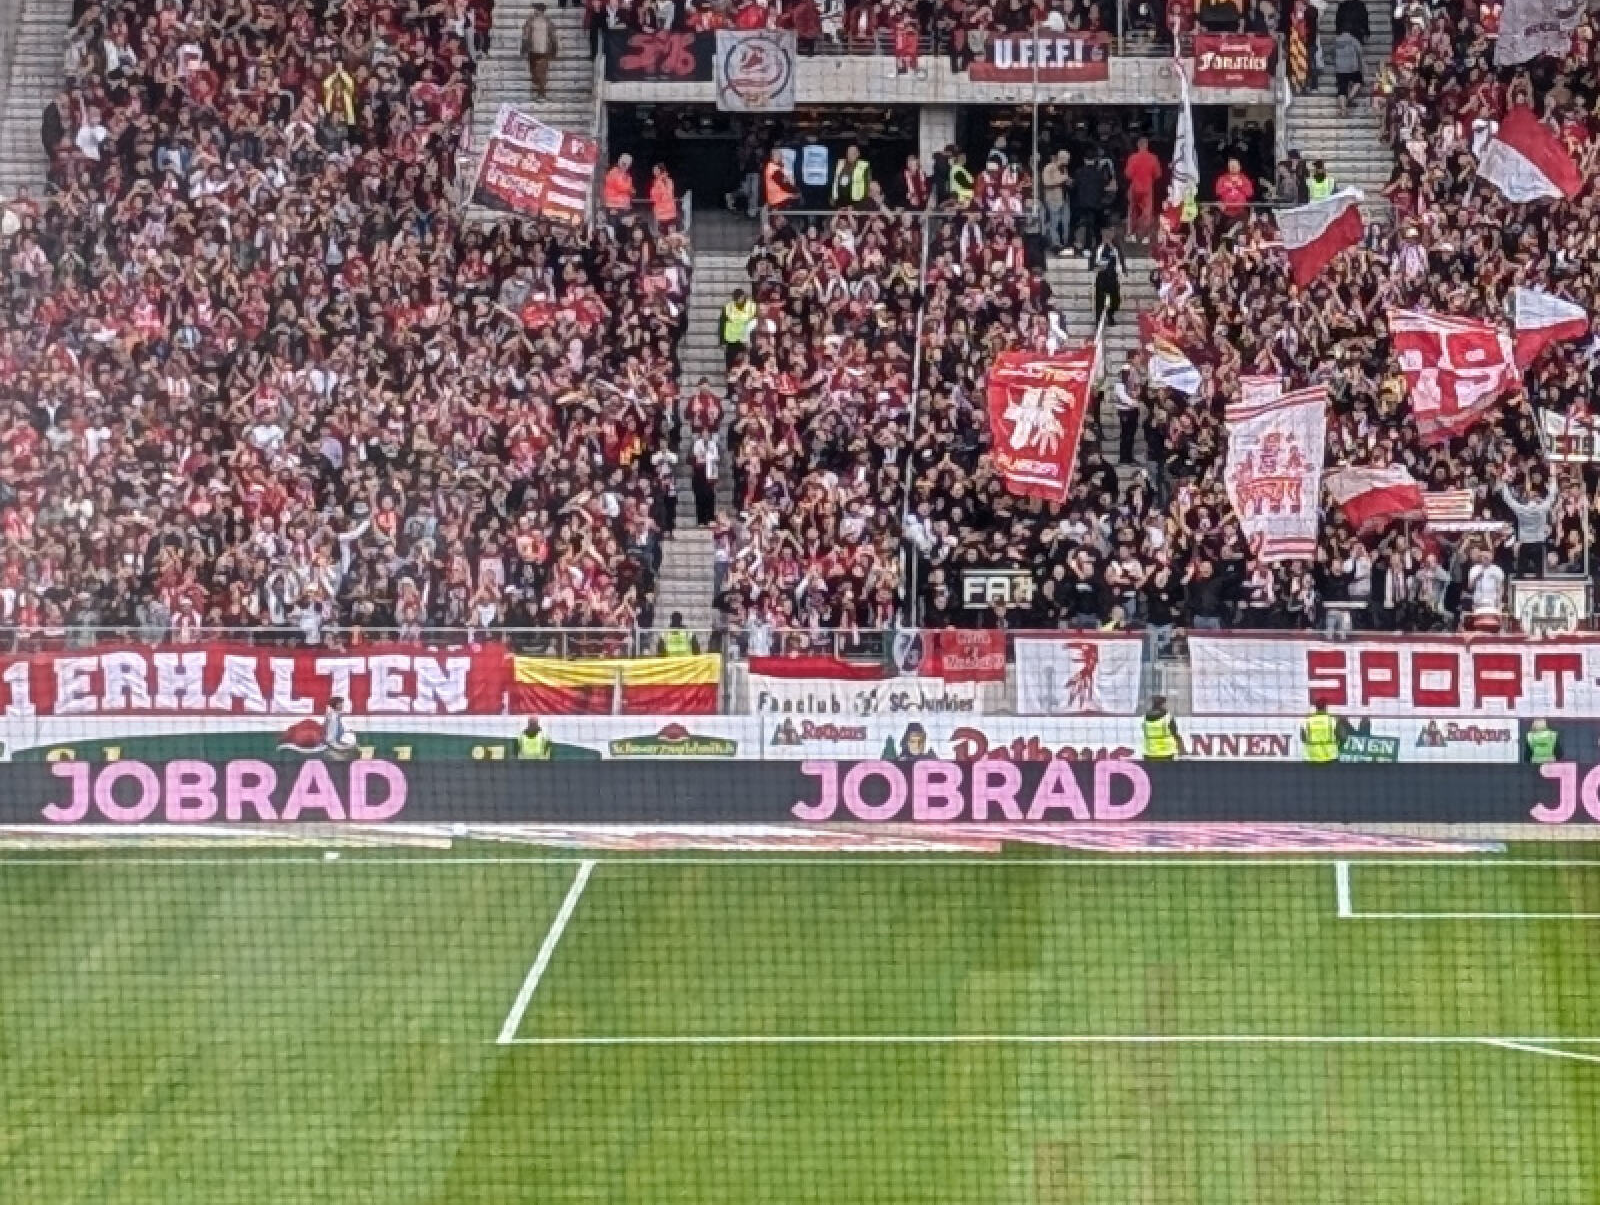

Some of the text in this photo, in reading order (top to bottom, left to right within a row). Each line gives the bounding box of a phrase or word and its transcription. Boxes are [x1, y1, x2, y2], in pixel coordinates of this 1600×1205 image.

[52, 649, 471, 714] ERHALTEN
[756, 690, 841, 714] Fanclub
[42, 758, 408, 823] JOBRAD
[790, 758, 1152, 821] JOBRAD
